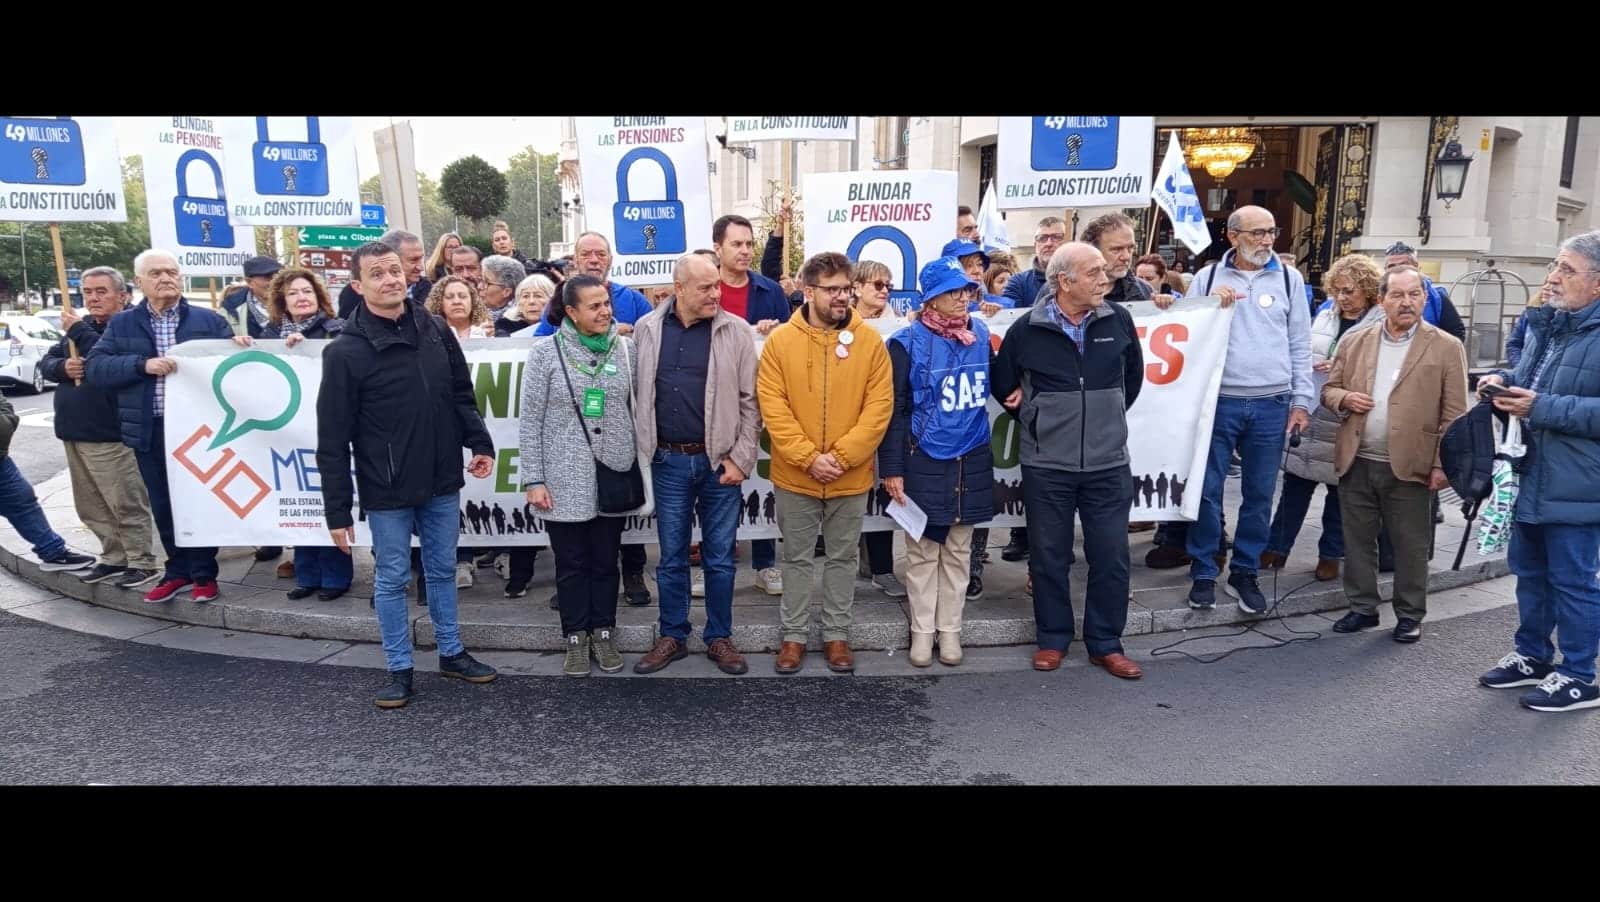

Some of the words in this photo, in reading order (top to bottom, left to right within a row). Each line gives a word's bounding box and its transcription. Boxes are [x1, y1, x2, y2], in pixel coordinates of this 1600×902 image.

[5, 123, 26, 143] 49
[26, 126, 71, 143] MILLONES
[734, 119, 746, 132] EN
[747, 119, 759, 131] LA
[159, 132, 174, 143] LAS
[176, 130, 223, 150] PENSIONE
[598, 134, 615, 146] LAS
[617, 127, 685, 145] PENSIONES
[262, 146, 280, 162] 49
[280, 148, 318, 162] MILLONES
[848, 182, 912, 201] BLINDAR
[1005, 184, 1020, 198] EN
[1021, 184, 1035, 197] LA
[1038, 173, 1143, 196] CONSTITUCIÓN
[9, 189, 116, 210] CONSTITUCIÓN
[182, 201, 198, 215] 49
[235, 205, 247, 216] EN
[249, 205, 261, 216] LA
[264, 199, 353, 216] CONSTITUCIÓN
[623, 206, 640, 221] 49
[641, 206, 676, 220] MILLONES
[827, 209, 848, 223] LAS
[851, 203, 933, 222] PENSIONES
[279, 497, 297, 506] MESA
[279, 509, 288, 517] DE
[290, 509, 302, 517] LAS
